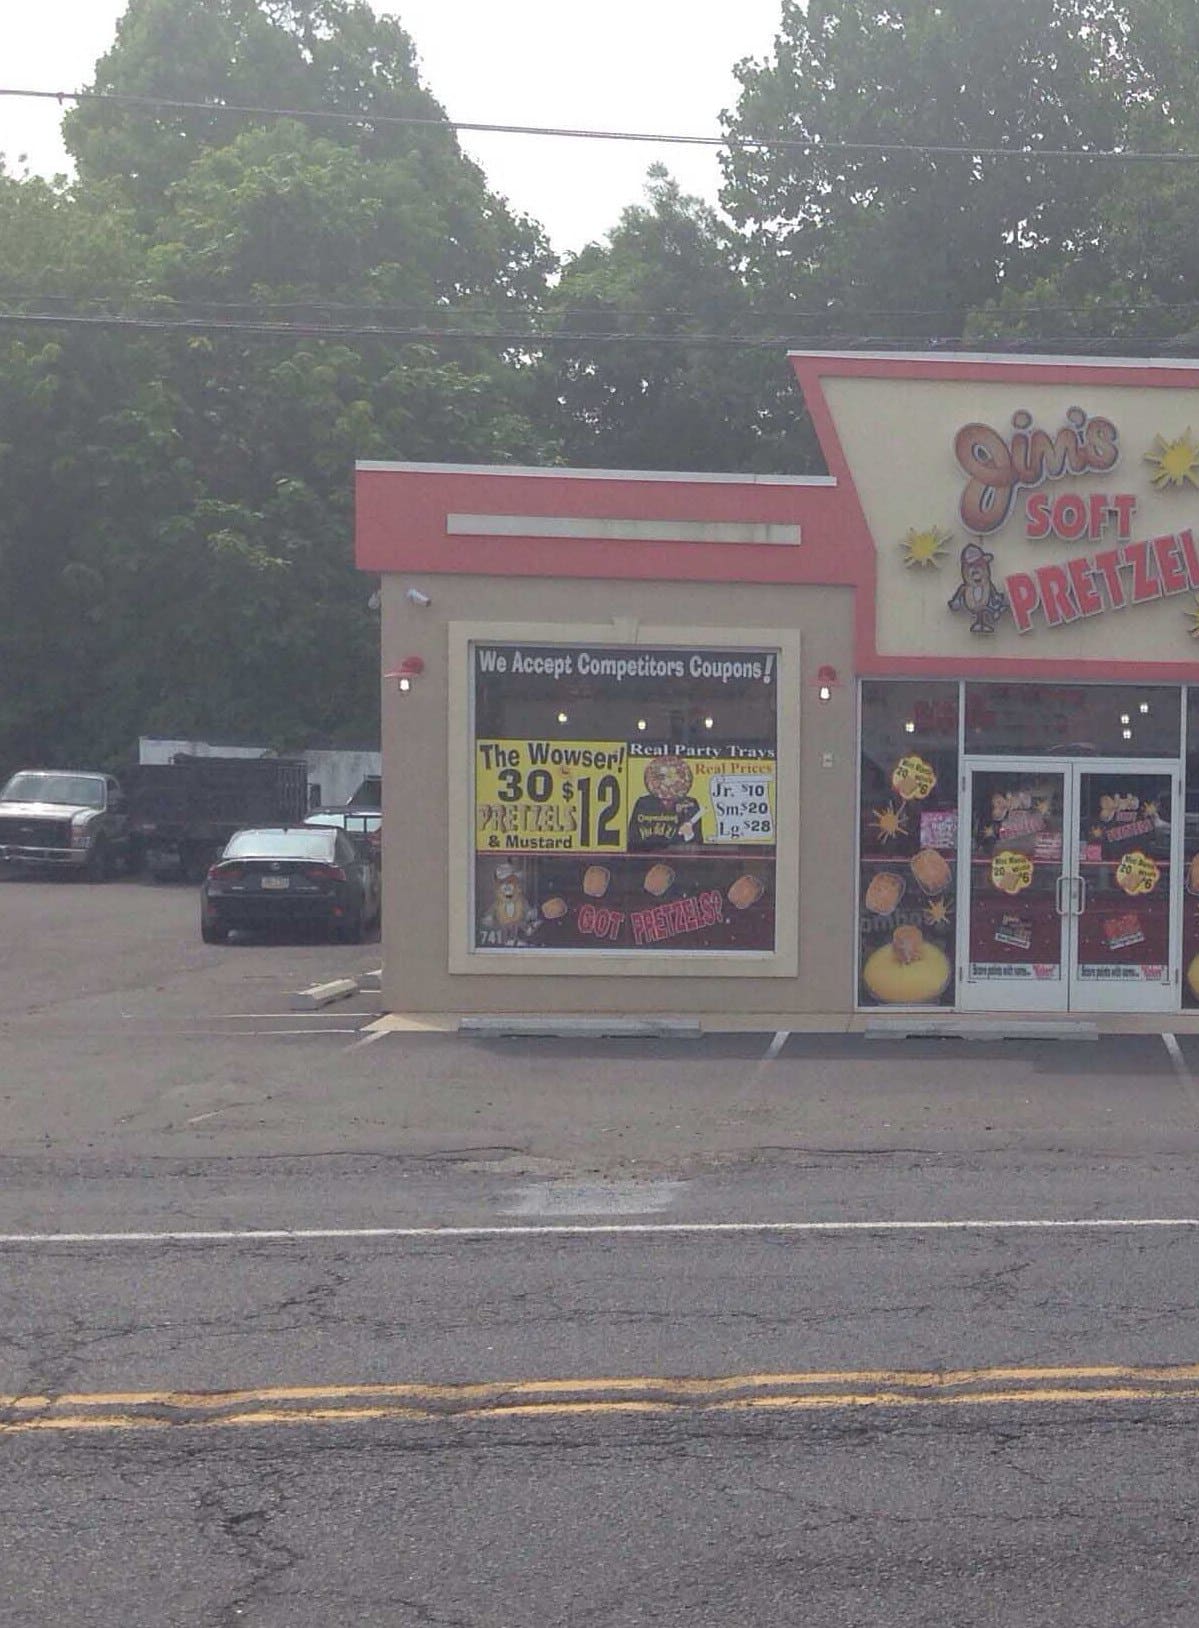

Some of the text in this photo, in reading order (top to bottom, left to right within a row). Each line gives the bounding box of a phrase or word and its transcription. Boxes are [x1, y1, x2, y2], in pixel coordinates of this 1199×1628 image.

[953, 406, 1121, 535] Jim's
[1024, 493, 1137, 540] SOFT
[479, 651, 773, 684] We Accept Competitors Coupons!
[479, 743, 625, 773] The Wowser!
[630, 743, 775, 760] Real Party Trays
[695, 762, 772, 775] Real Prices
[497, 768, 554, 803] 30
[712, 783, 765, 798] Jr. $10
[479, 804, 577, 833] PRETZELS
[562, 775, 620, 847] $12
[716, 802, 768, 816] Sm. $20
[488, 835, 572, 849] & Mustard
[720, 820, 771, 838] Lg. $28
[578, 904, 625, 940] GOT
